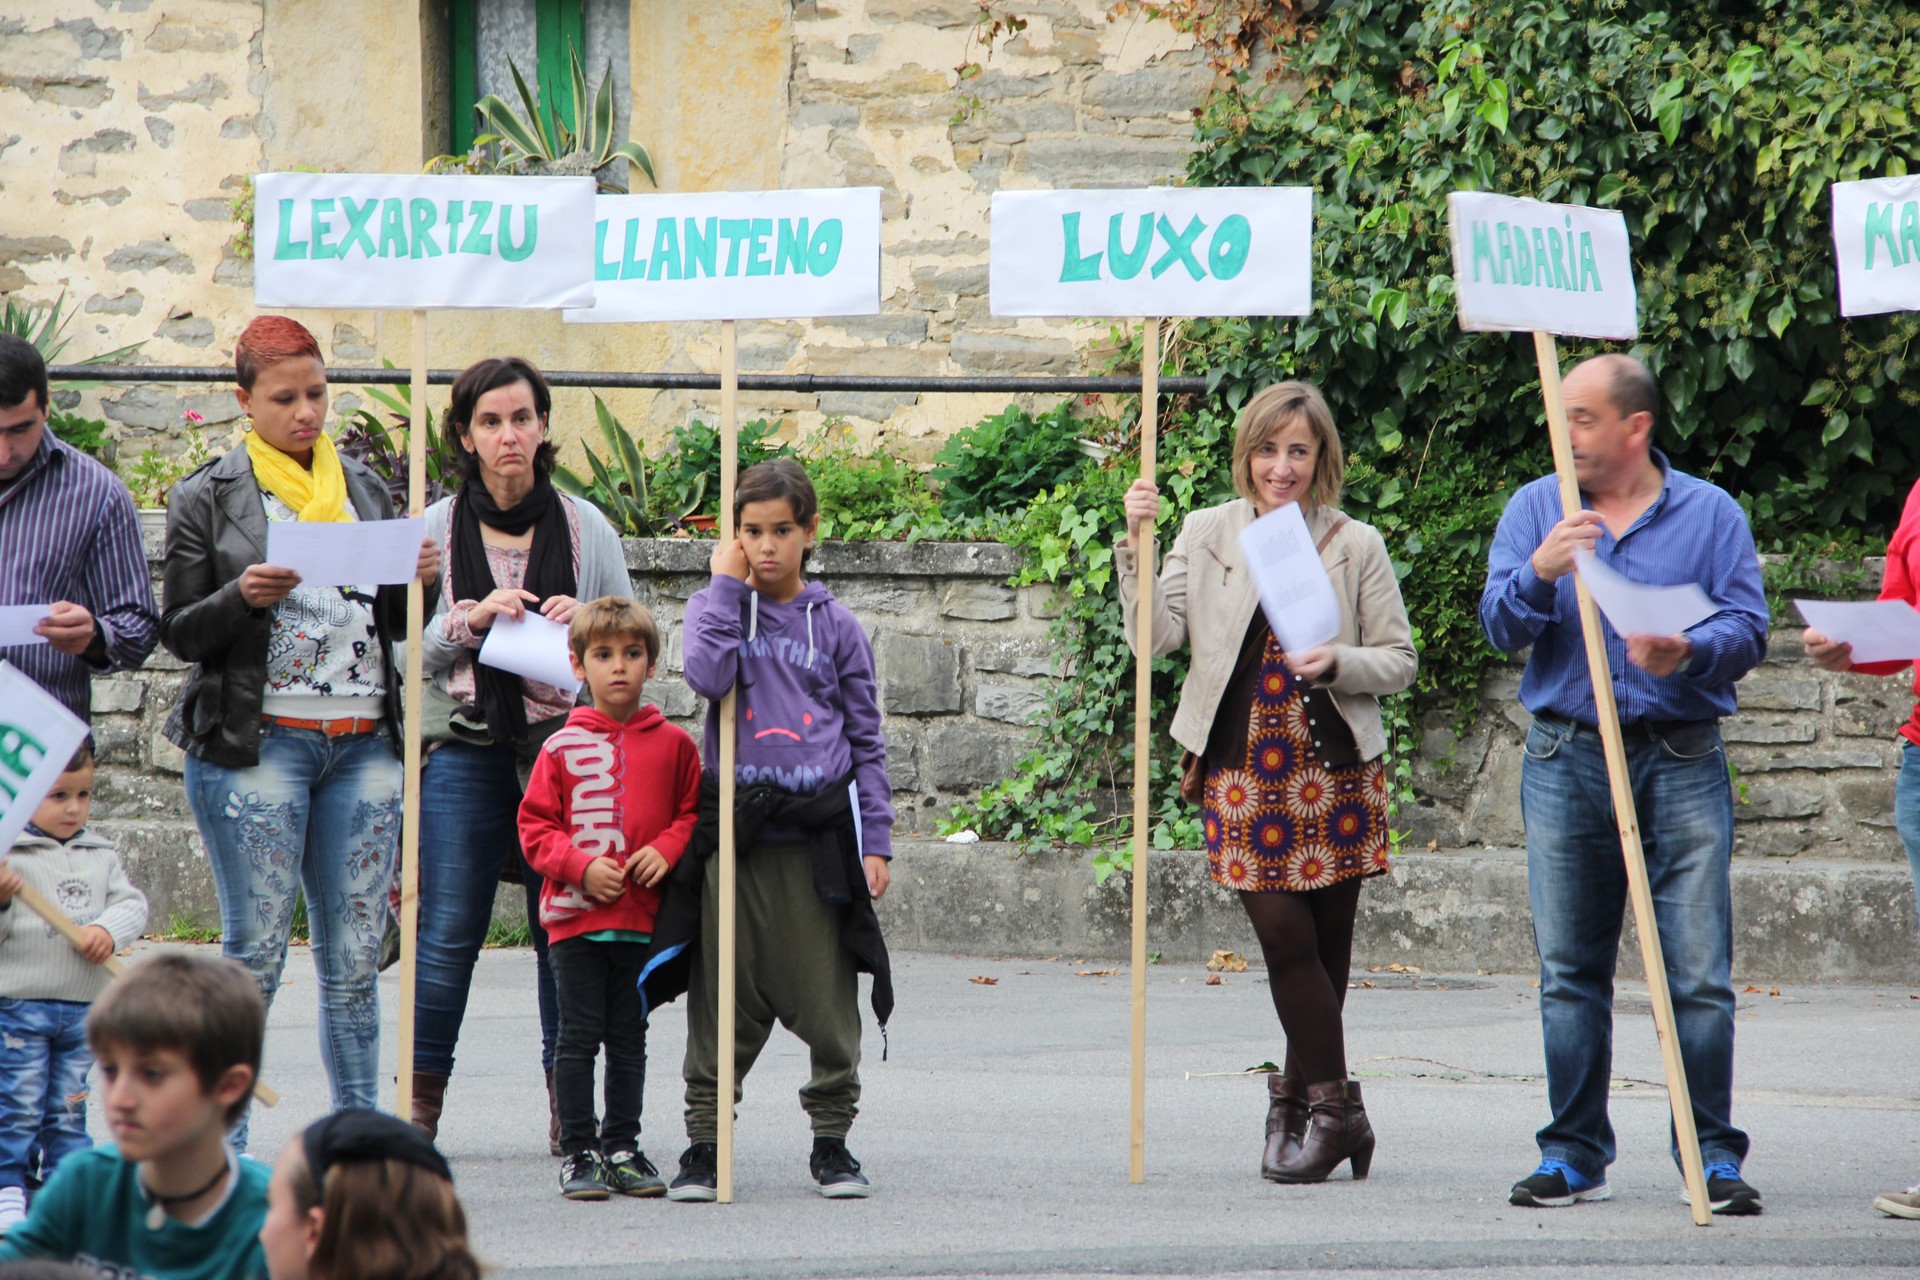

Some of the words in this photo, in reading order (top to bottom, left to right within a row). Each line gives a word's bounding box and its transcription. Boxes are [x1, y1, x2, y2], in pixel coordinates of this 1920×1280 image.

[273, 196, 538, 262] LEXARIZU
[594, 216, 843, 281] LLANTENO
[1059, 211, 1252, 283] LUXO
